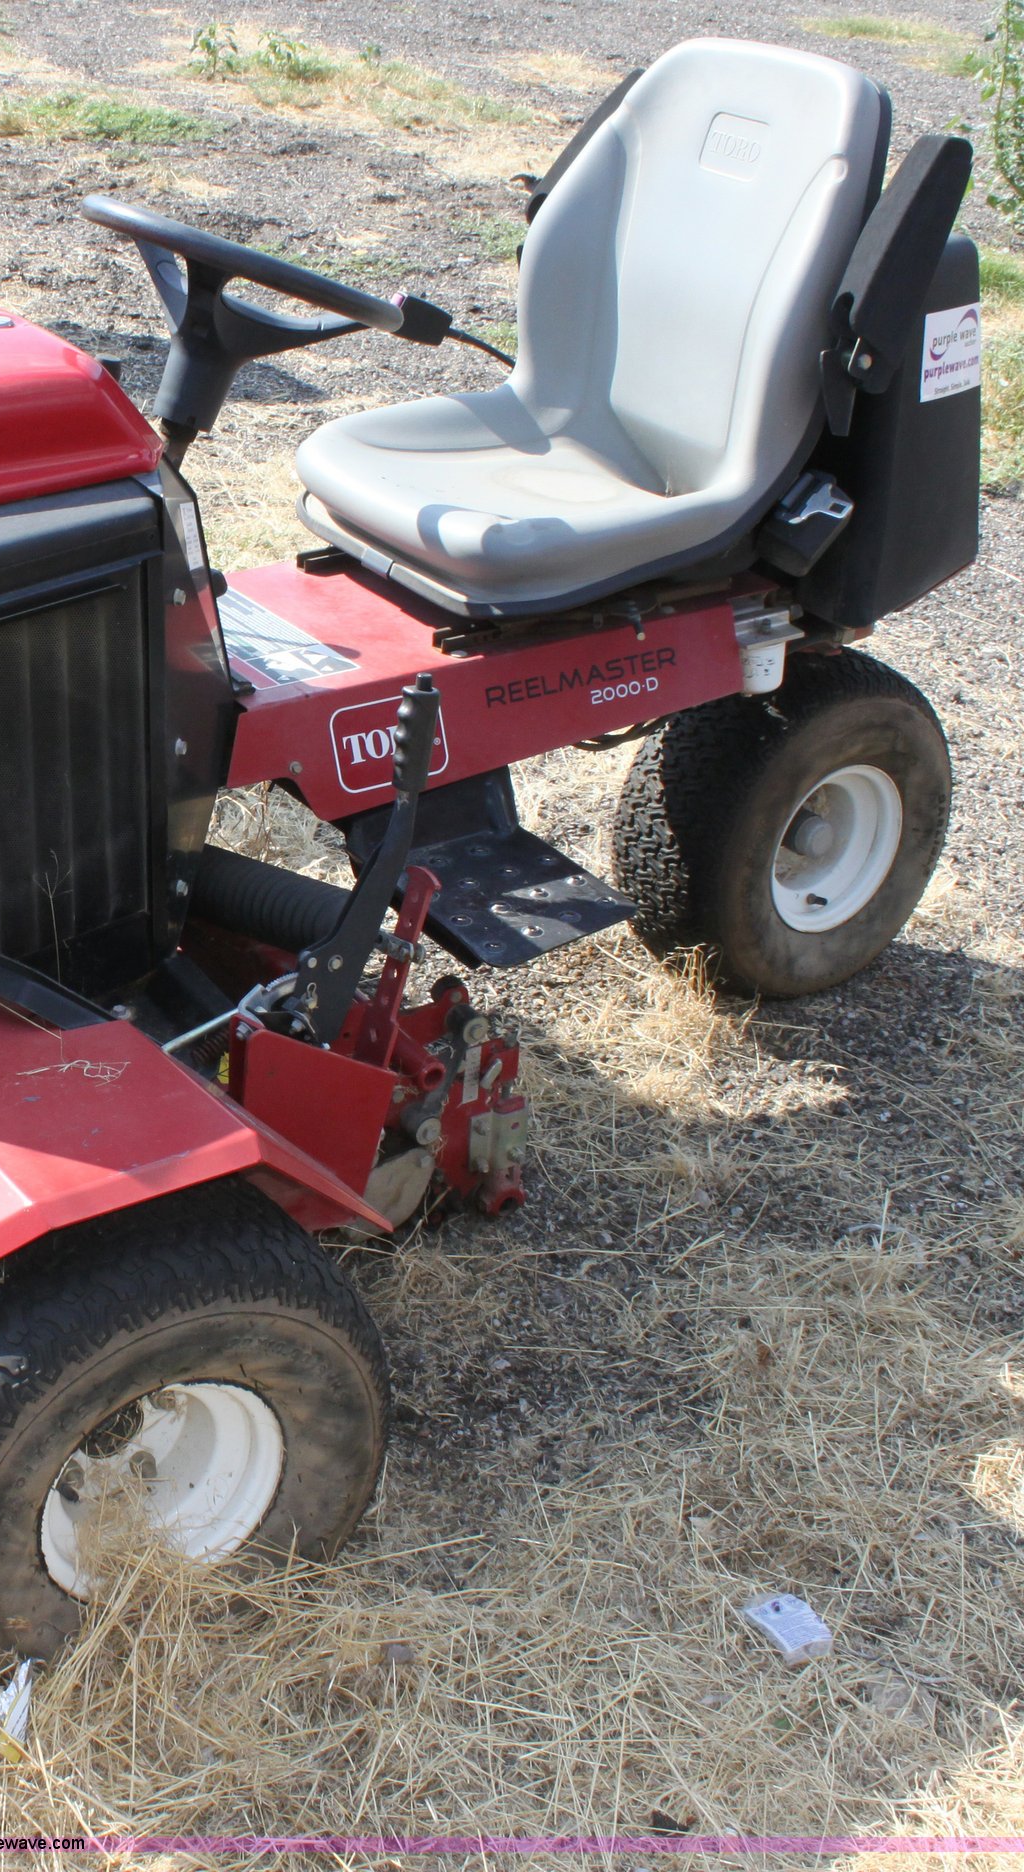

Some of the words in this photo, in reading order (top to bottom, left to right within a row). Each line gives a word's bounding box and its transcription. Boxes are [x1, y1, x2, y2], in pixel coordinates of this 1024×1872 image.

[710, 131, 762, 165] TORO
[932, 330, 957, 349] purple
[959, 328, 976, 340] wave
[924, 356, 979, 382] purplewave.com
[485, 647, 676, 708] REELMASTER
[342, 725, 397, 765] TO
